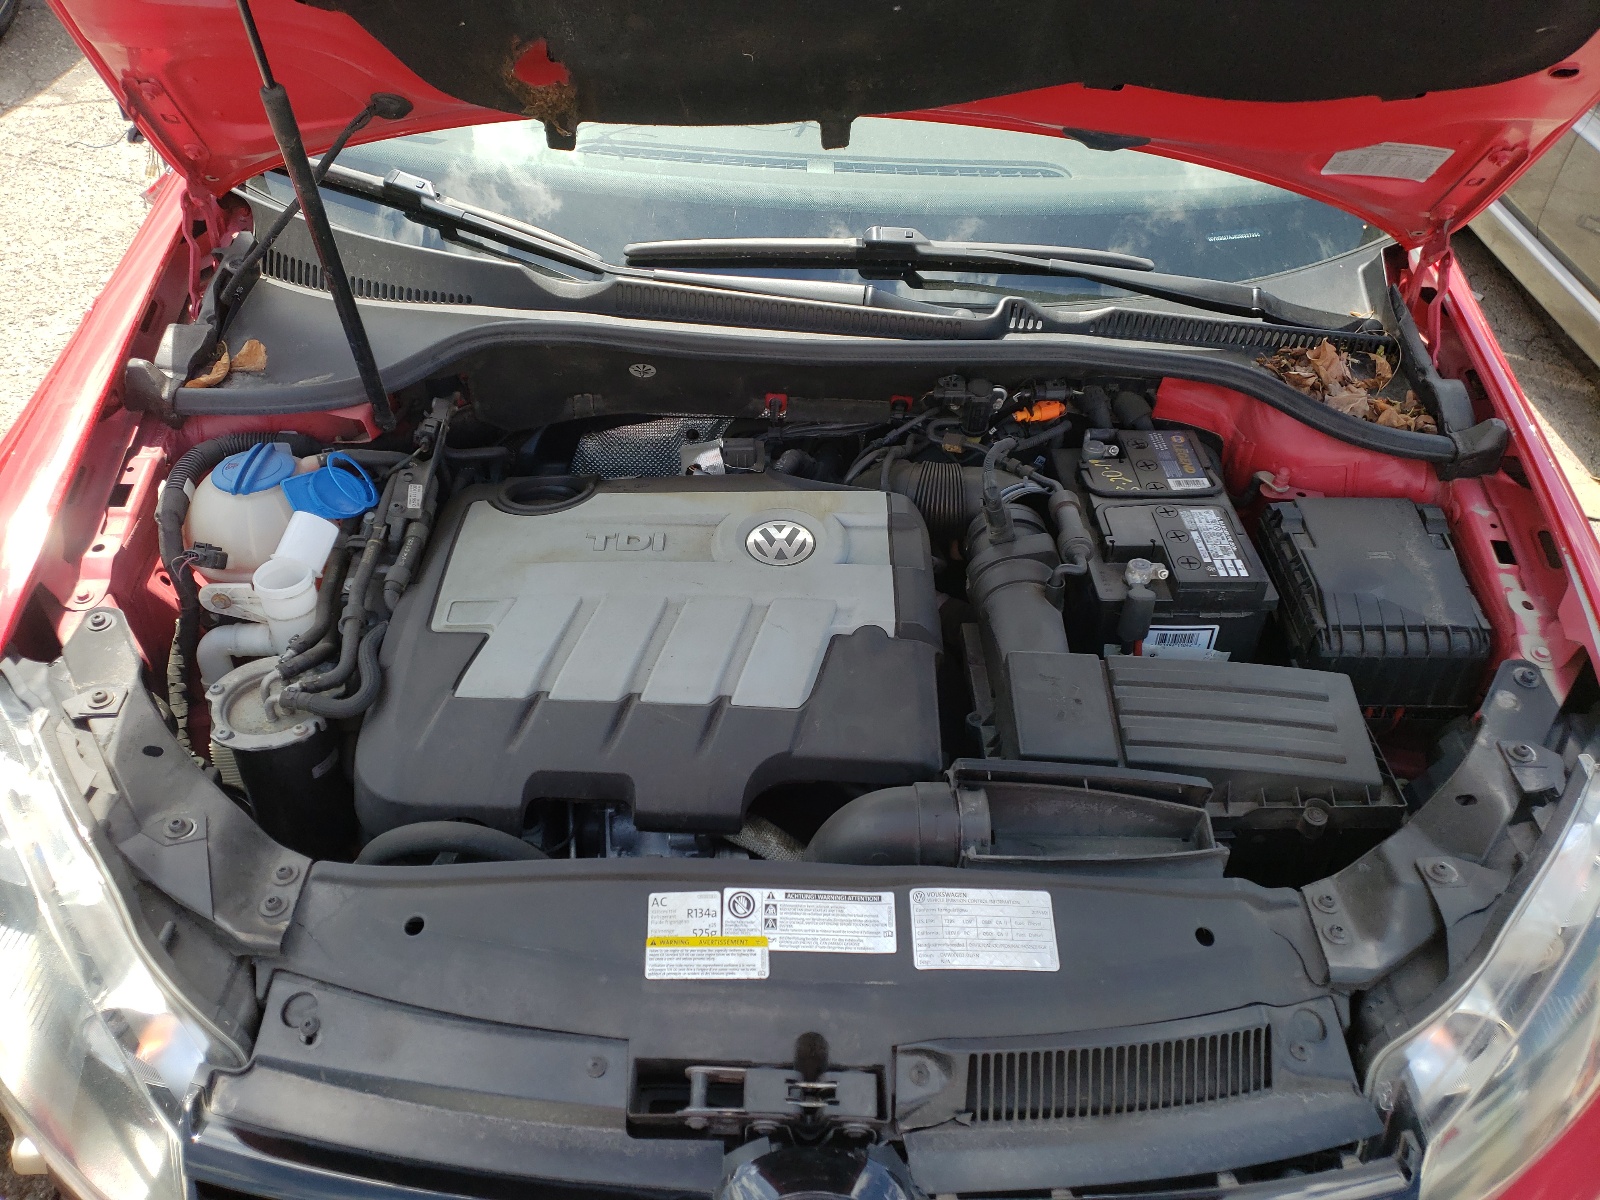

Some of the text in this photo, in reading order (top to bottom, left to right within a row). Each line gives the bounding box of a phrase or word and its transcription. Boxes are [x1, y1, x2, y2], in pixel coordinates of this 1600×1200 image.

[585, 532, 667, 551] TDI
[651, 897, 668, 907] AC
[686, 908, 717, 919] R134a
[692, 928, 718, 937] 525g
